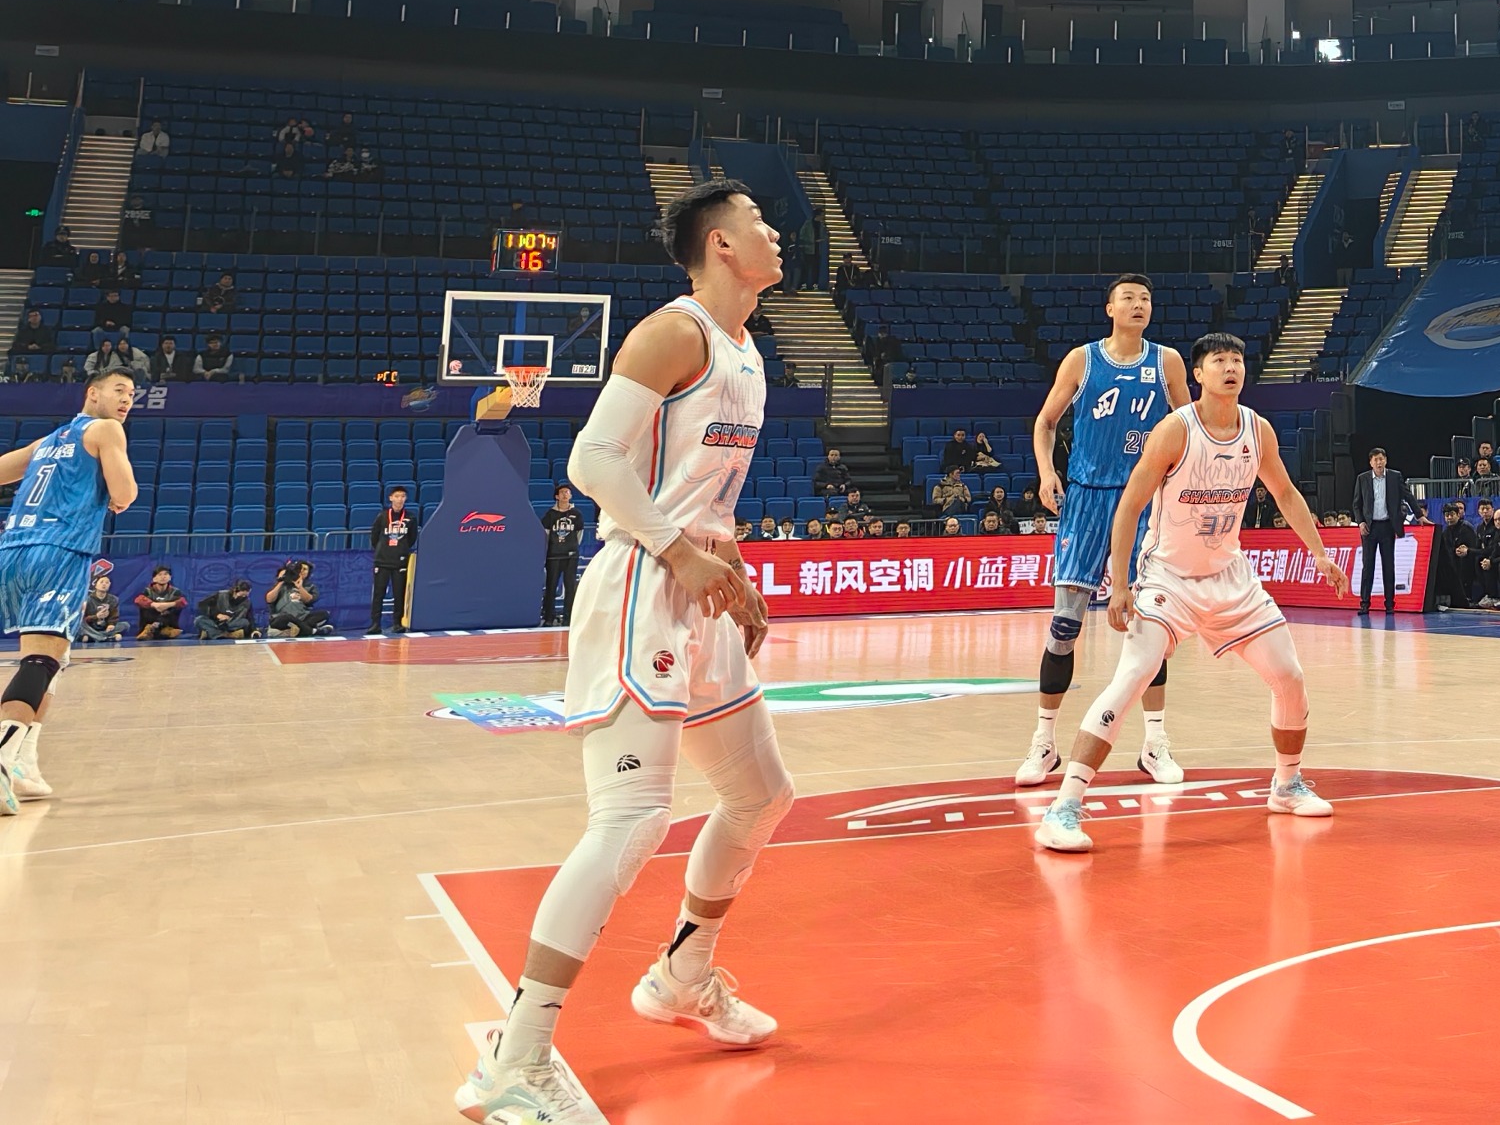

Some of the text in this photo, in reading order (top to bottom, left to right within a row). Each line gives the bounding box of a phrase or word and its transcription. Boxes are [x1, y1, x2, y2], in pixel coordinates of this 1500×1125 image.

[521, 251, 543, 271] 16
[25, 463, 57, 507] 1
[459, 524, 506, 533] LI-NING
[799, 558, 934, 596] 新风空调
[1243, 548, 1289, 583] 风空调
